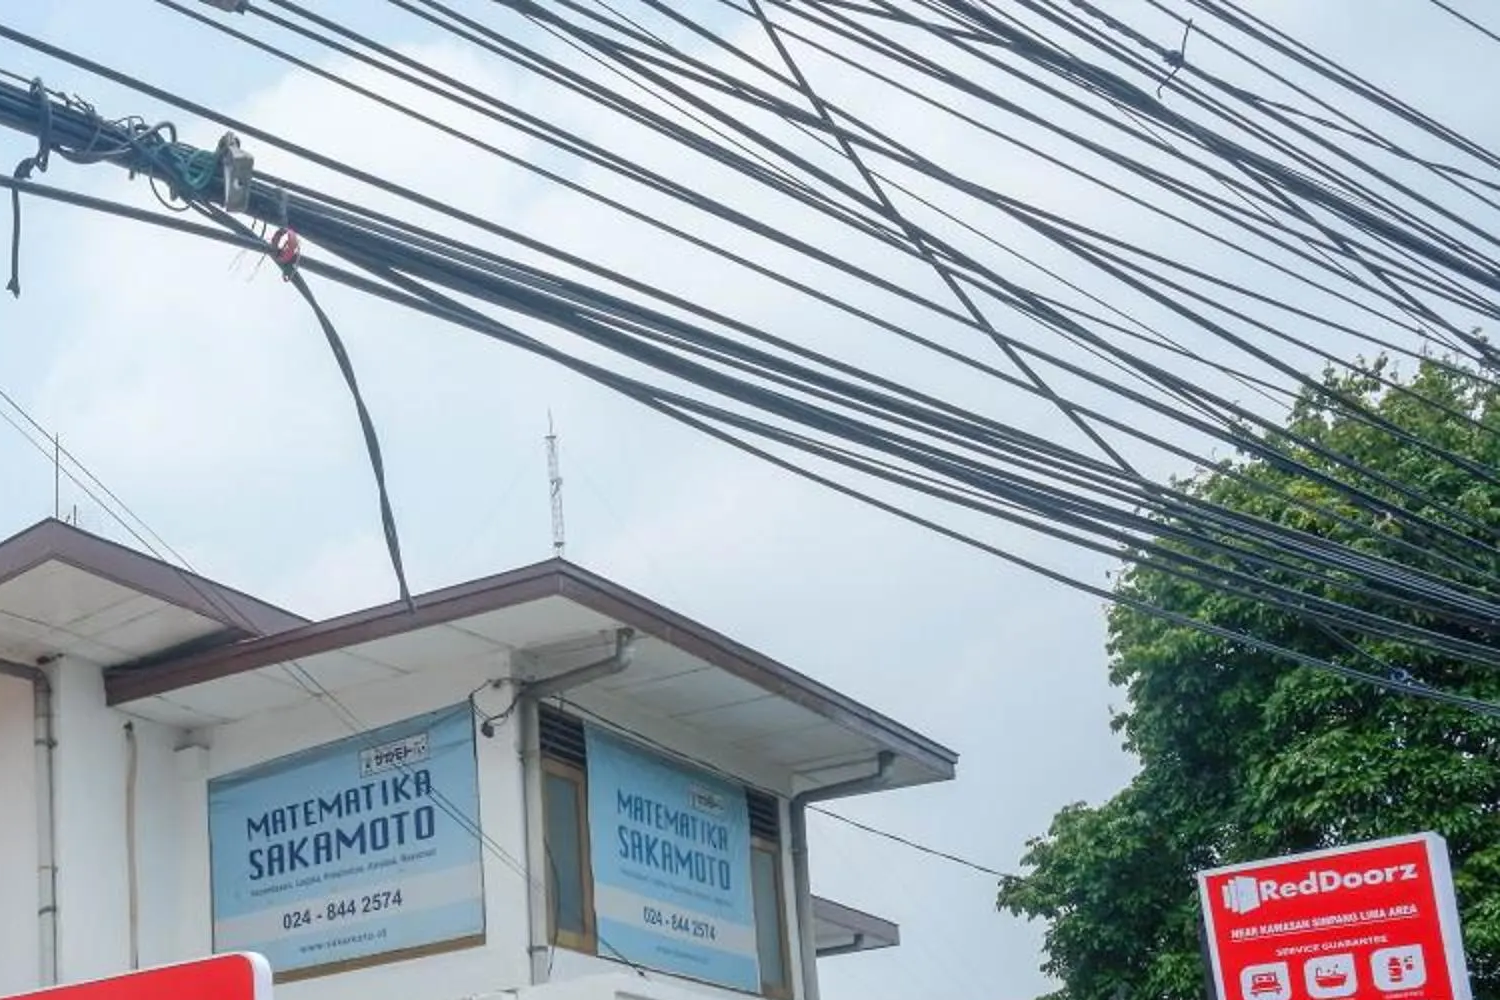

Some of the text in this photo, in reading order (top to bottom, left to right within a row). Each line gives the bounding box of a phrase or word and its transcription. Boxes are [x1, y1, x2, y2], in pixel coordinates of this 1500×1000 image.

[247, 769, 432, 842] MATEMATIKA
[617, 788, 728, 851] MATEMATIKA
[248, 805, 435, 881] SAKAMOTO
[618, 825, 731, 890] SAKAMOTO
[1259, 863, 1418, 902] RedDoorz
[283, 909, 311, 929] 024
[327, 899, 356, 921] 844
[361, 889, 403, 913] 2574
[643, 906, 663, 927] 024
[671, 913, 690, 933] 844
[1231, 903, 1418, 940] NEAR KAWASAN SIMPANG LIMA AREA
[1275, 944, 1320, 957] SERVICE
